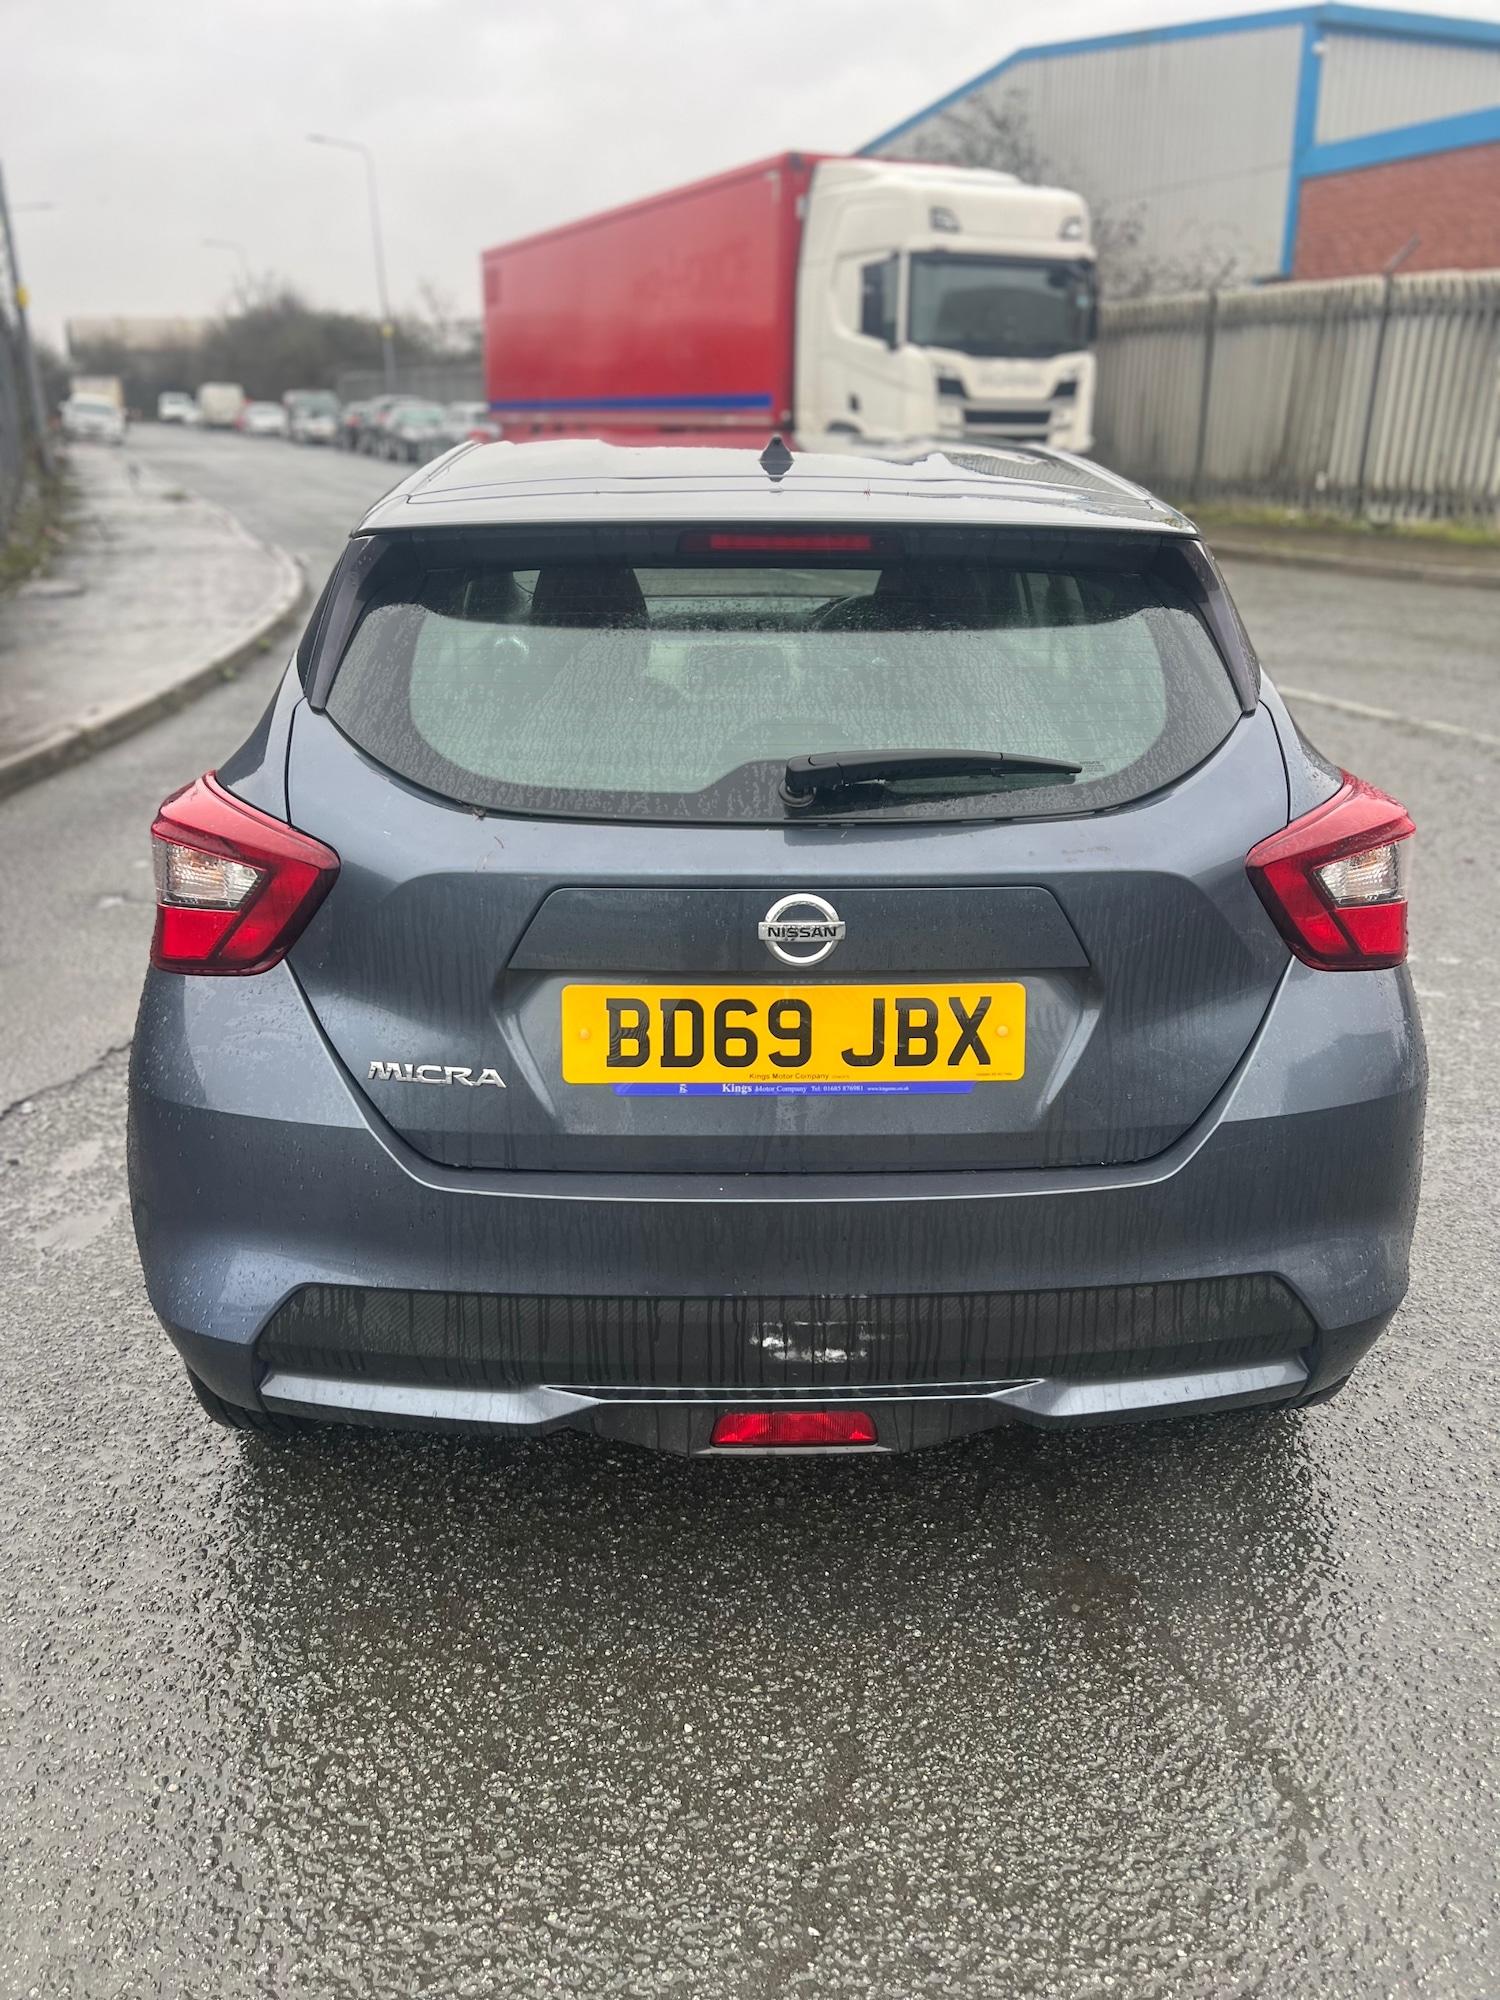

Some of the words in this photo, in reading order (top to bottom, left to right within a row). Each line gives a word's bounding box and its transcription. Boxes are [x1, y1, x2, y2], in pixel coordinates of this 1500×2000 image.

[768, 926, 837, 938] NISSAN
[605, 997, 813, 1068] BD69
[841, 996, 993, 1067] JBX
[367, 1061, 507, 1089] MICRA
[749, 1073, 770, 1081] Kings
[722, 1083, 752, 1095] Kings
[776, 1085, 807, 1093] Company
